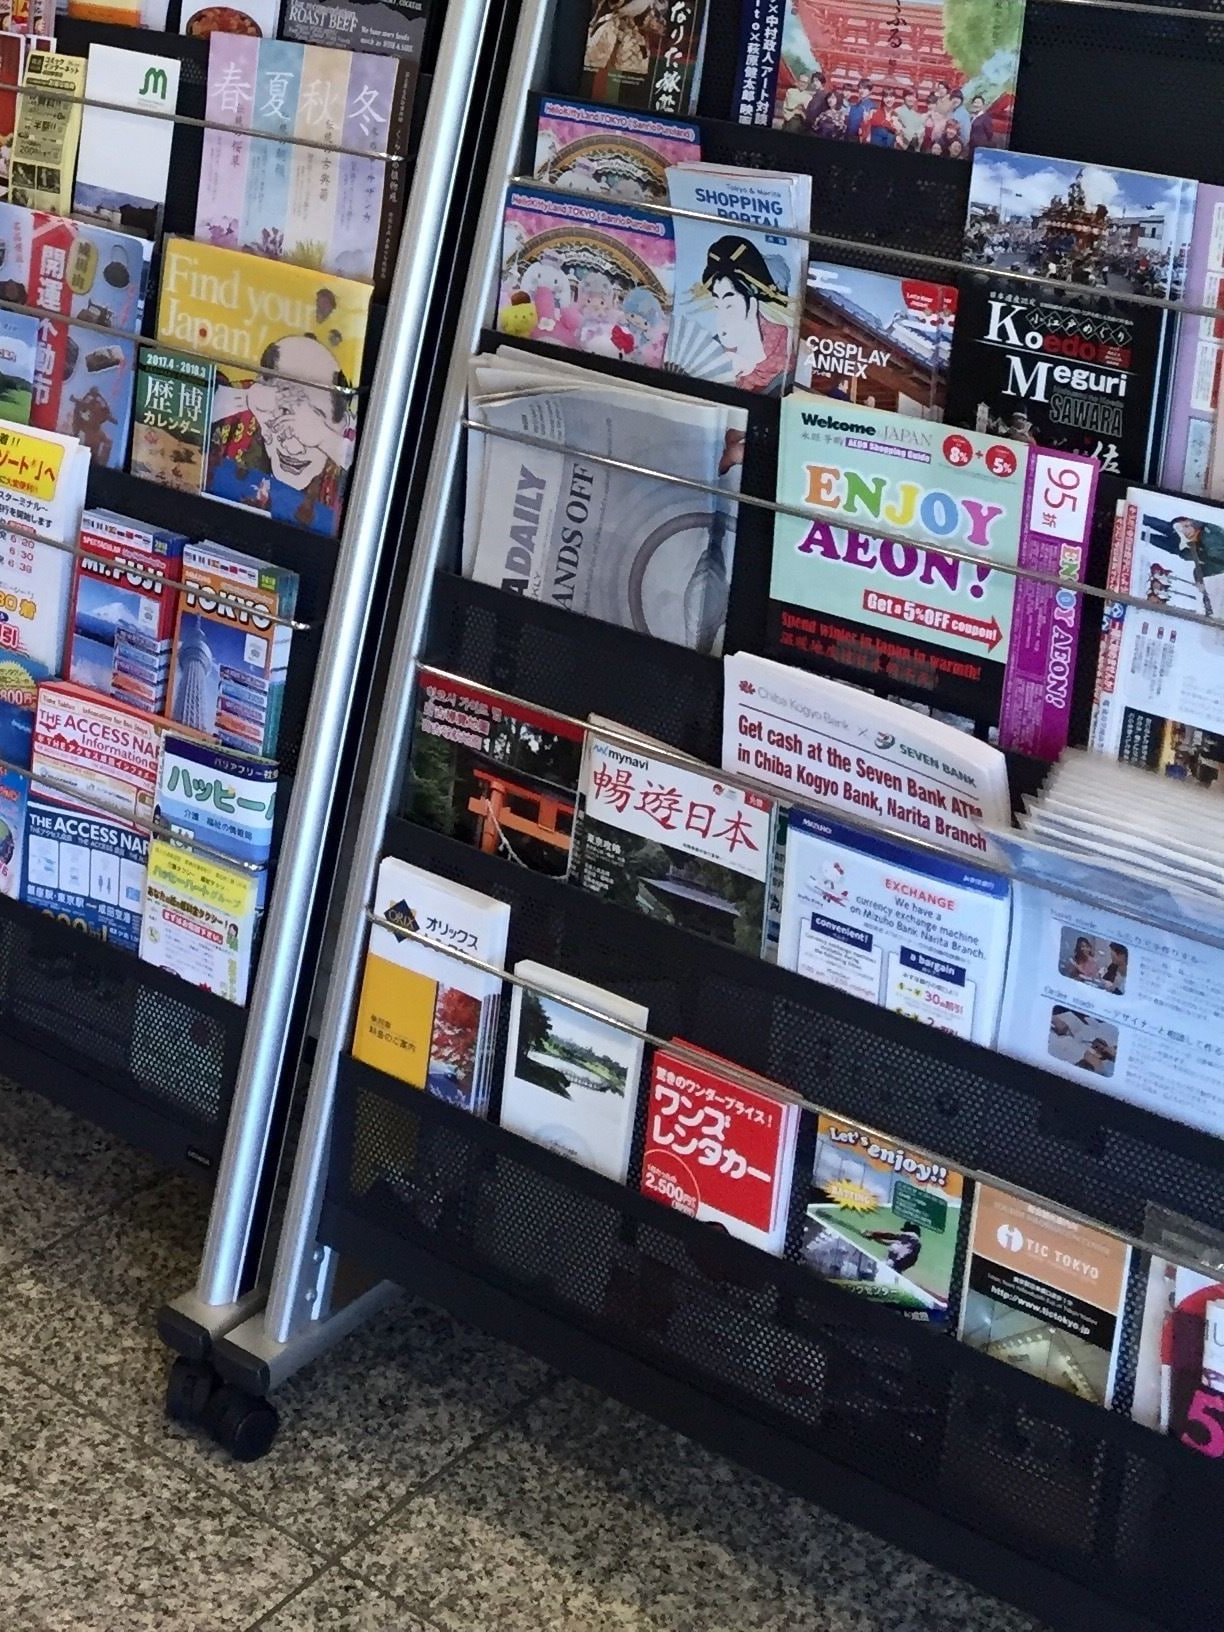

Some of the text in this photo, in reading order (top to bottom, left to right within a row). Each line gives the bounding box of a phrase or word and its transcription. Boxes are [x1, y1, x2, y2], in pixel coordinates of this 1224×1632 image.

[289, 8, 359, 33] ROAST BEEF
[695, 187, 783, 216] SHOPPING
[164, 252, 315, 330] Find your
[161, 298, 268, 362] Japan!
[983, 299, 1096, 361] Koedo
[1030, 312, 1126, 343] 小江戸めぐり
[804, 353, 869, 380] ANNEX
[806, 336, 892, 368] COSPLAY
[144, 375, 204, 421] 歴博
[1001, 354, 1128, 404] Meguri
[143, 411, 201, 435] カレンダー
[801, 412, 933, 447] Welcome JAPAN
[1049, 392, 1124, 438] SAWARA
[948, 446, 969, 463] 8%
[992, 457, 1013, 474] 5%
[565, 463, 594, 525] OFF
[805, 464, 1004, 546] ENJOY
[506, 464, 547, 581] DAILY
[797, 520, 998, 599] AEON!
[867, 593, 893, 613] Get
[893, 604, 902, 614] a
[951, 620, 997, 641] coupon!
[1045, 626, 1075, 709] AEON!
[39, 708, 62, 726] THE
[64, 714, 130, 747] ACCESS
[758, 686, 787, 708] Chiba
[788, 698, 824, 724] Kogyo
[823, 711, 849, 730] Bank
[899, 743, 940, 770] SEVEN
[941, 757, 978, 789] BANK
[81, 734, 148, 768] Information
[608, 747, 649, 771] mynavi
[738, 714, 763, 742] Get
[767, 728, 803, 756] cash
[807, 741, 823, 761] at
[826, 745, 852, 774] the
[855, 757, 902, 793] Seven
[907, 776, 947, 811] Bank
[593, 762, 760, 854] 暢遊日本
[738, 742, 988, 852] in Chiba Kogyo Bank, Narita Branch
[29, 814, 53, 829] THE
[54, 816, 118, 846] ACCESS
[884, 877, 955, 911] EXCHANGE
[894, 896, 942, 922] We have a
[426, 916, 479, 951] オリックス
[815, 915, 870, 945] convenient!
[849, 905, 862, 915] on
[863, 908, 895, 928] Mizuho
[920, 926, 949, 949] Narita
[855, 895, 980, 947] currency exchange machine
[918, 953, 956, 977] bargain
[654, 1085, 731, 1141] ワンズ
[652, 1116, 771, 1184] レンタカー
[867, 1141, 947, 1185] enjoy!!
[1026, 1237, 1099, 1280] TIC TOKYO
